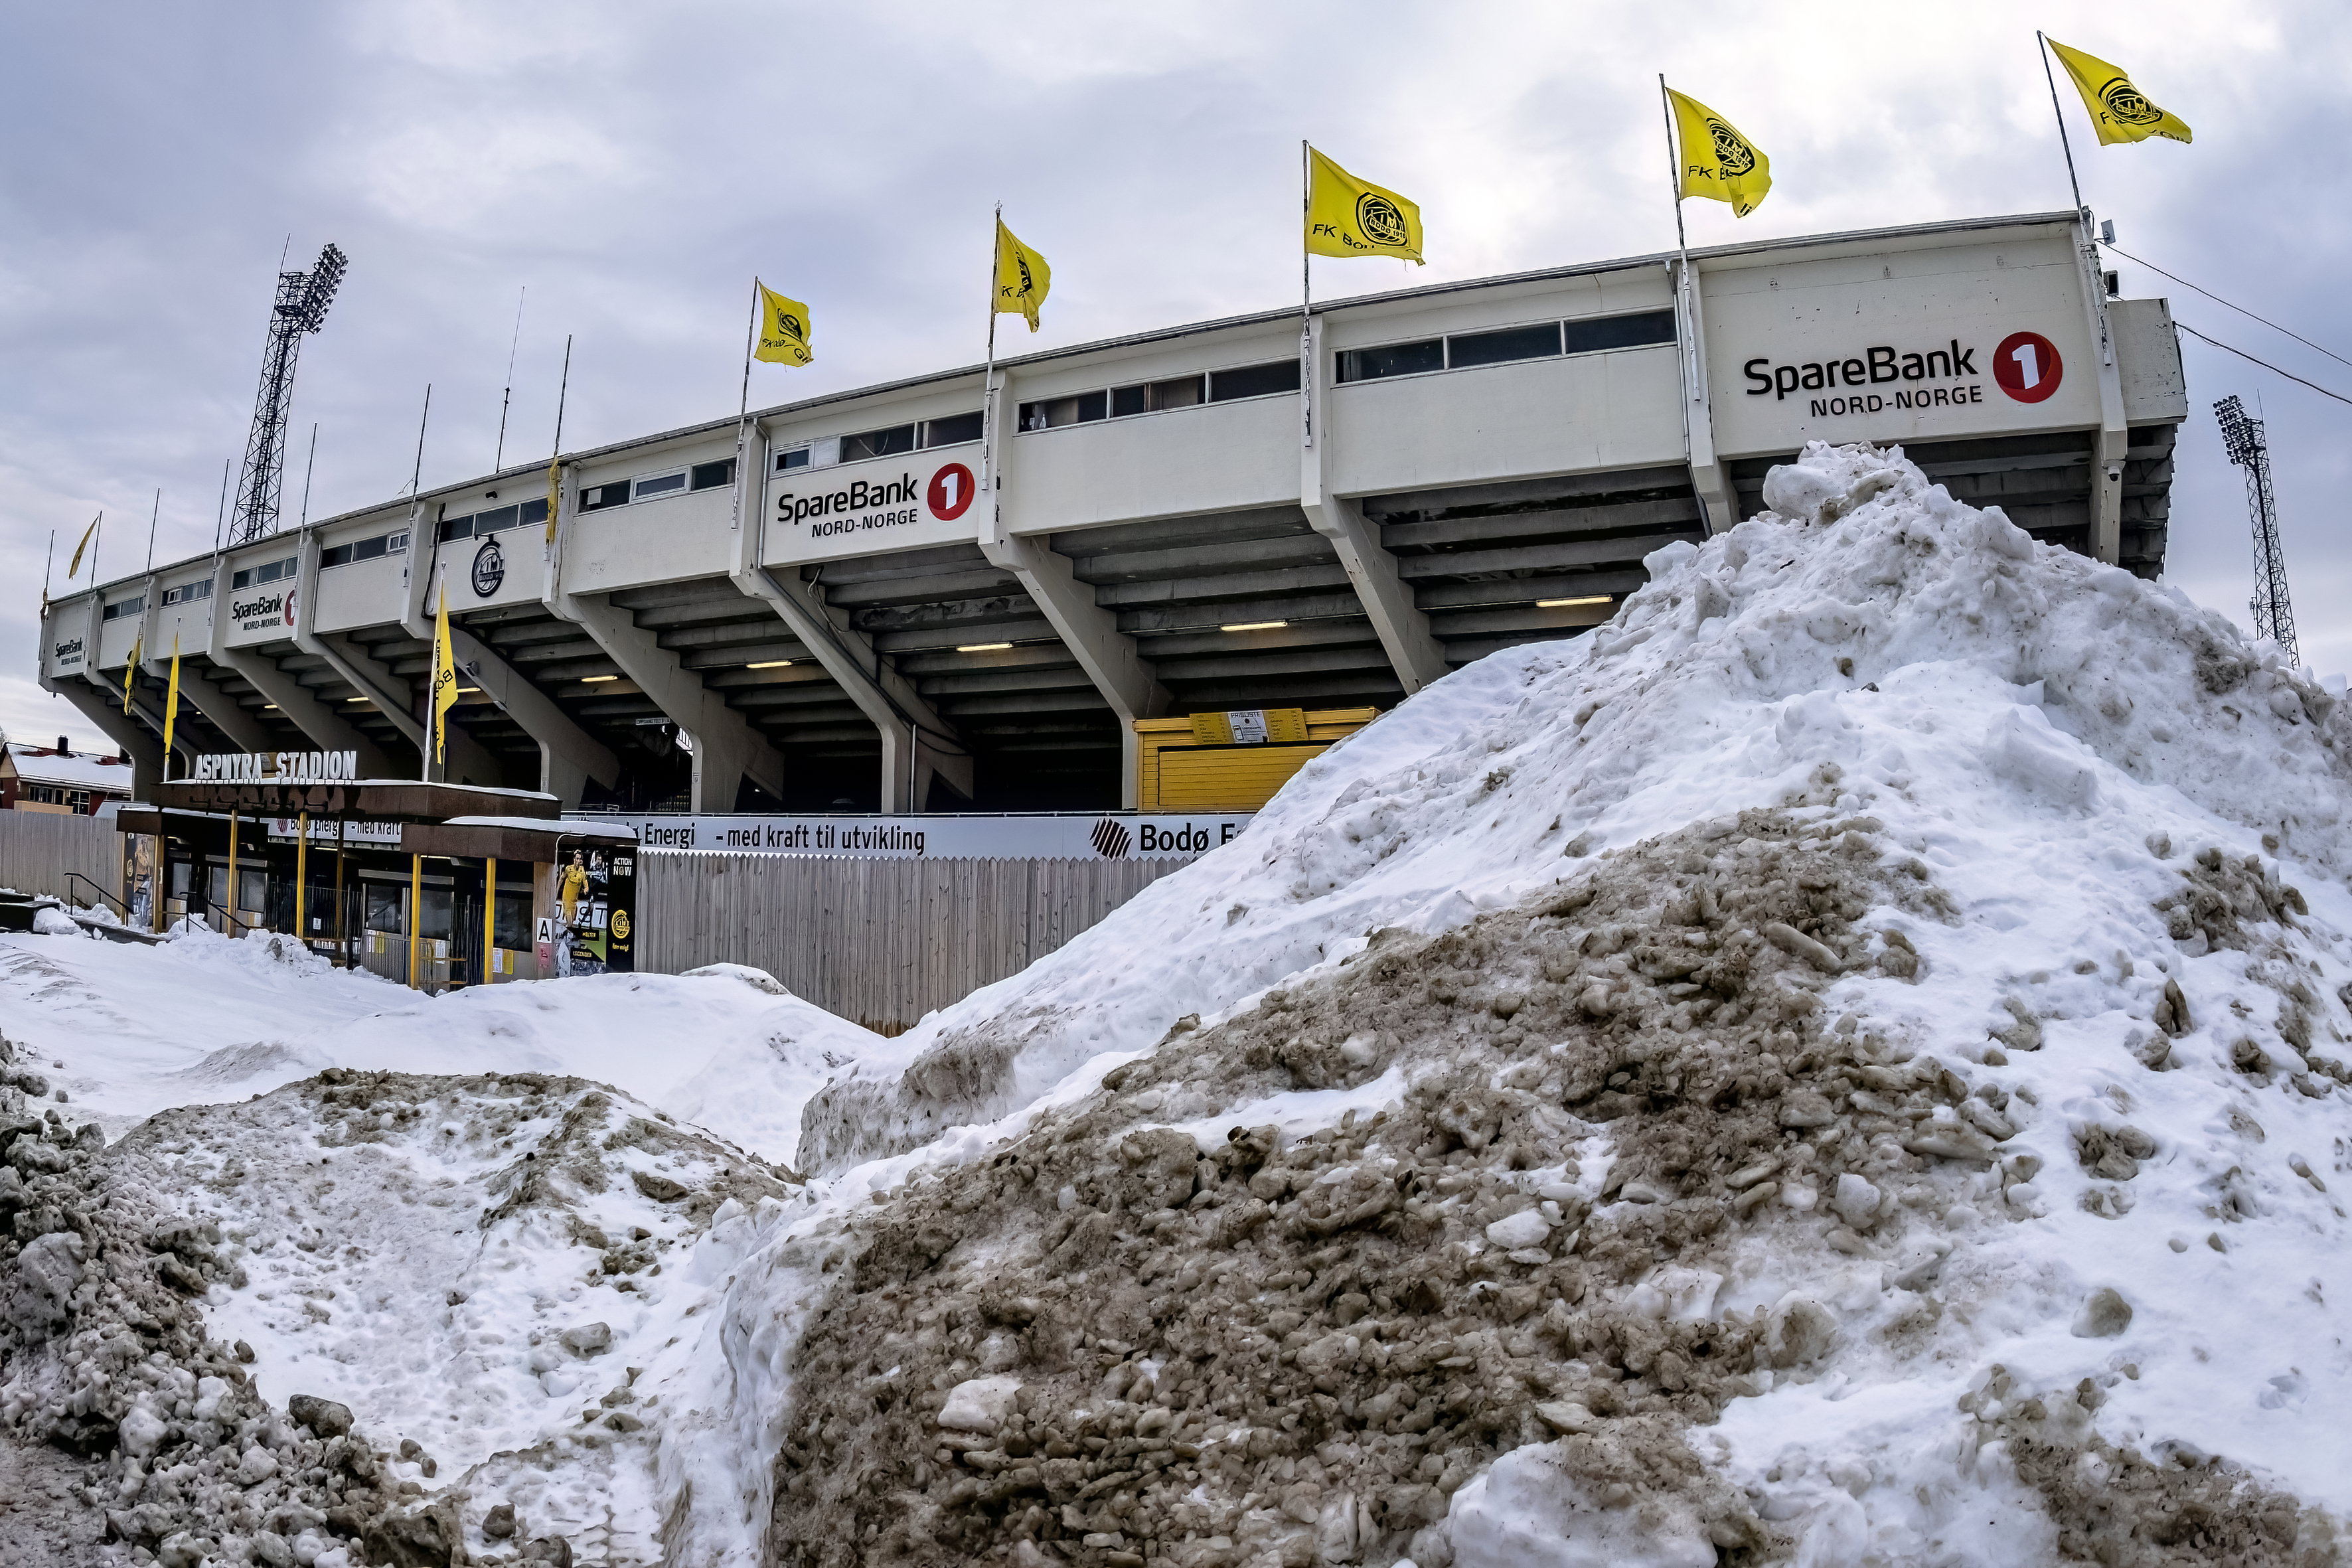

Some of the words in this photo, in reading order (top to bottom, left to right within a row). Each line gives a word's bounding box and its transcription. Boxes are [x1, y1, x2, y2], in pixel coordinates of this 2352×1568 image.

[1688, 165, 1713, 179] FK
[1312, 224, 1338, 238] FK
[1744, 339, 1978, 400] SpareBank
[1811, 386, 1983, 418] NORD-NORGE
[777, 472, 919, 525] SpareBank
[811, 509, 918, 538] NORD-NORGE
[232, 593, 283, 623] SpareBank
[243, 617, 281, 631] NORD-NORGE
[195, 753, 262, 779] ASPMYRA
[275, 751, 356, 779] STADION
[645, 823, 695, 850] Energi
[767, 824, 809, 848] kraft
[816, 824, 834, 849] til
[842, 825, 925, 856] utvikling
[1140, 822, 1210, 854] Bodø
[538, 920, 550, 941] A
